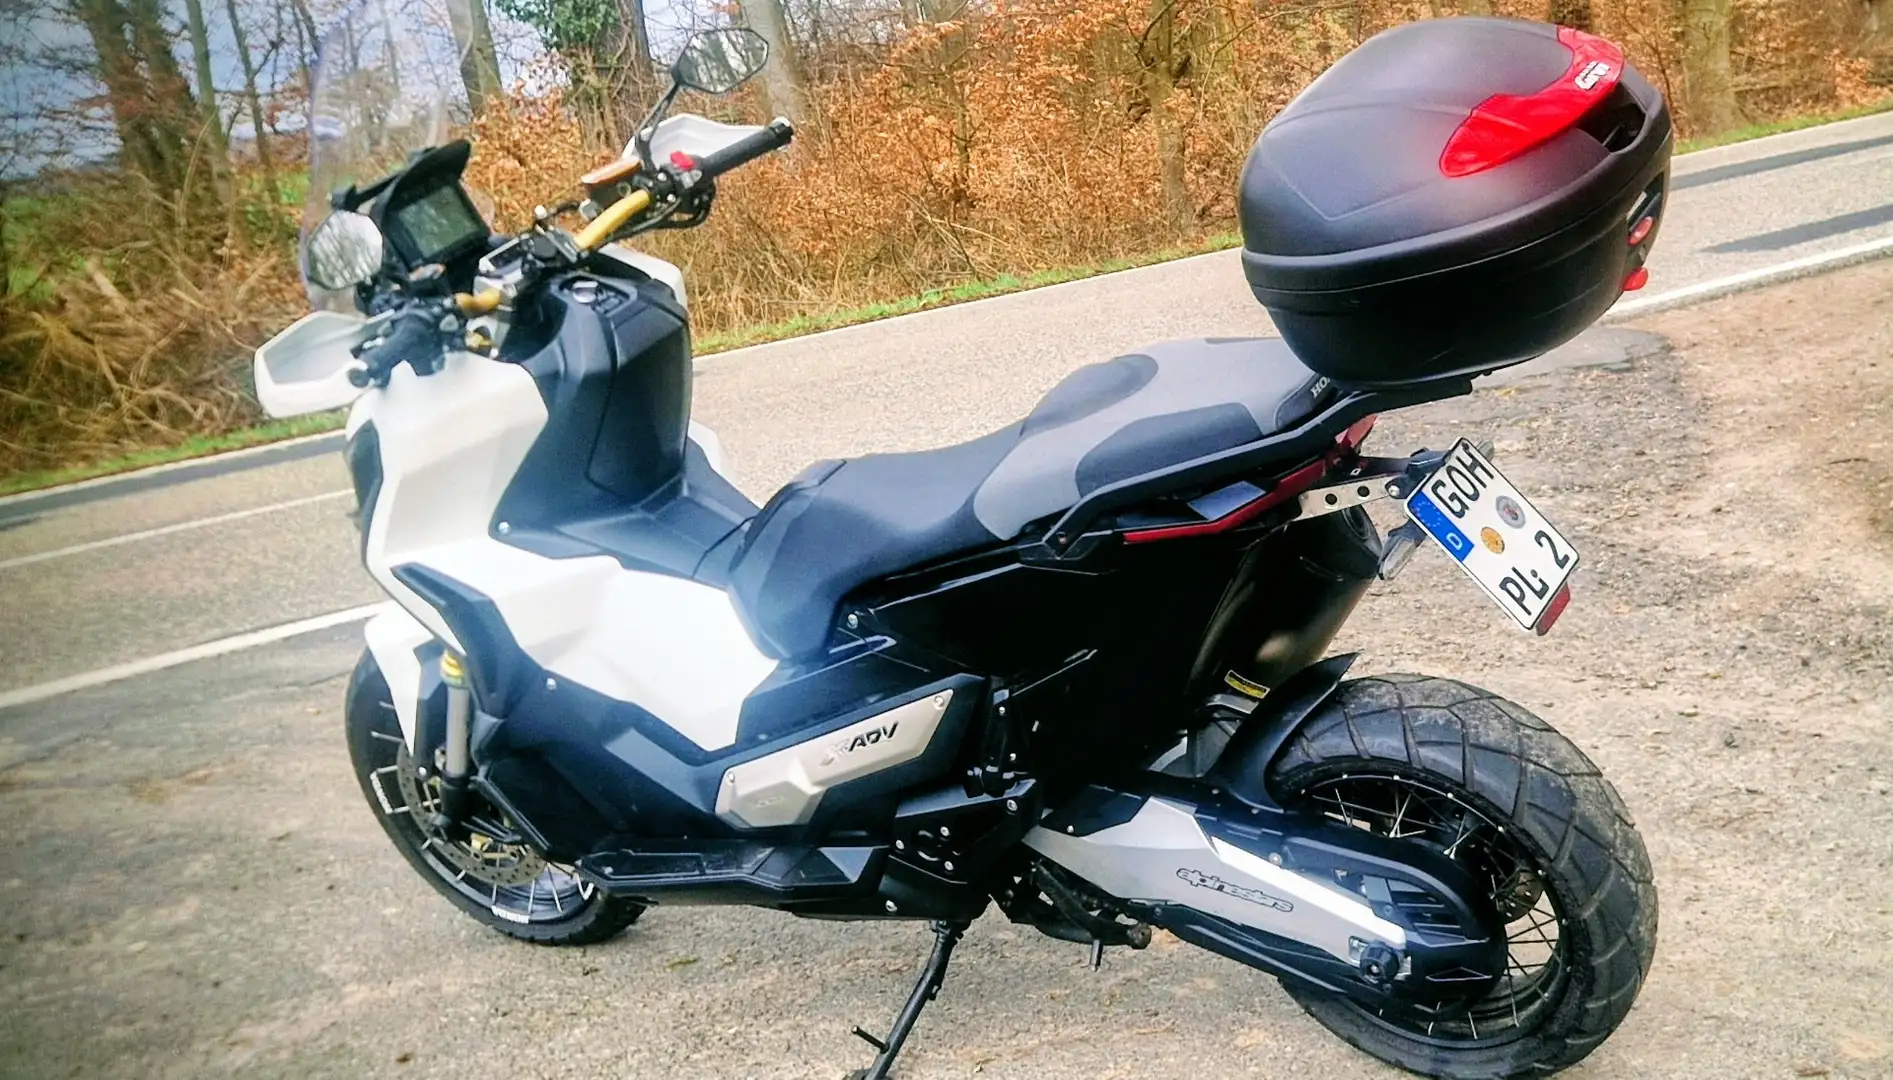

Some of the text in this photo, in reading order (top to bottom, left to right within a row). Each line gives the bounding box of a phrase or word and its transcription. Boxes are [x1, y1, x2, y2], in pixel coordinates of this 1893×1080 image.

[1430, 450, 1495, 519] GOH
[1446, 532, 1463, 551] D
[1499, 530, 1570, 616] PL 2
